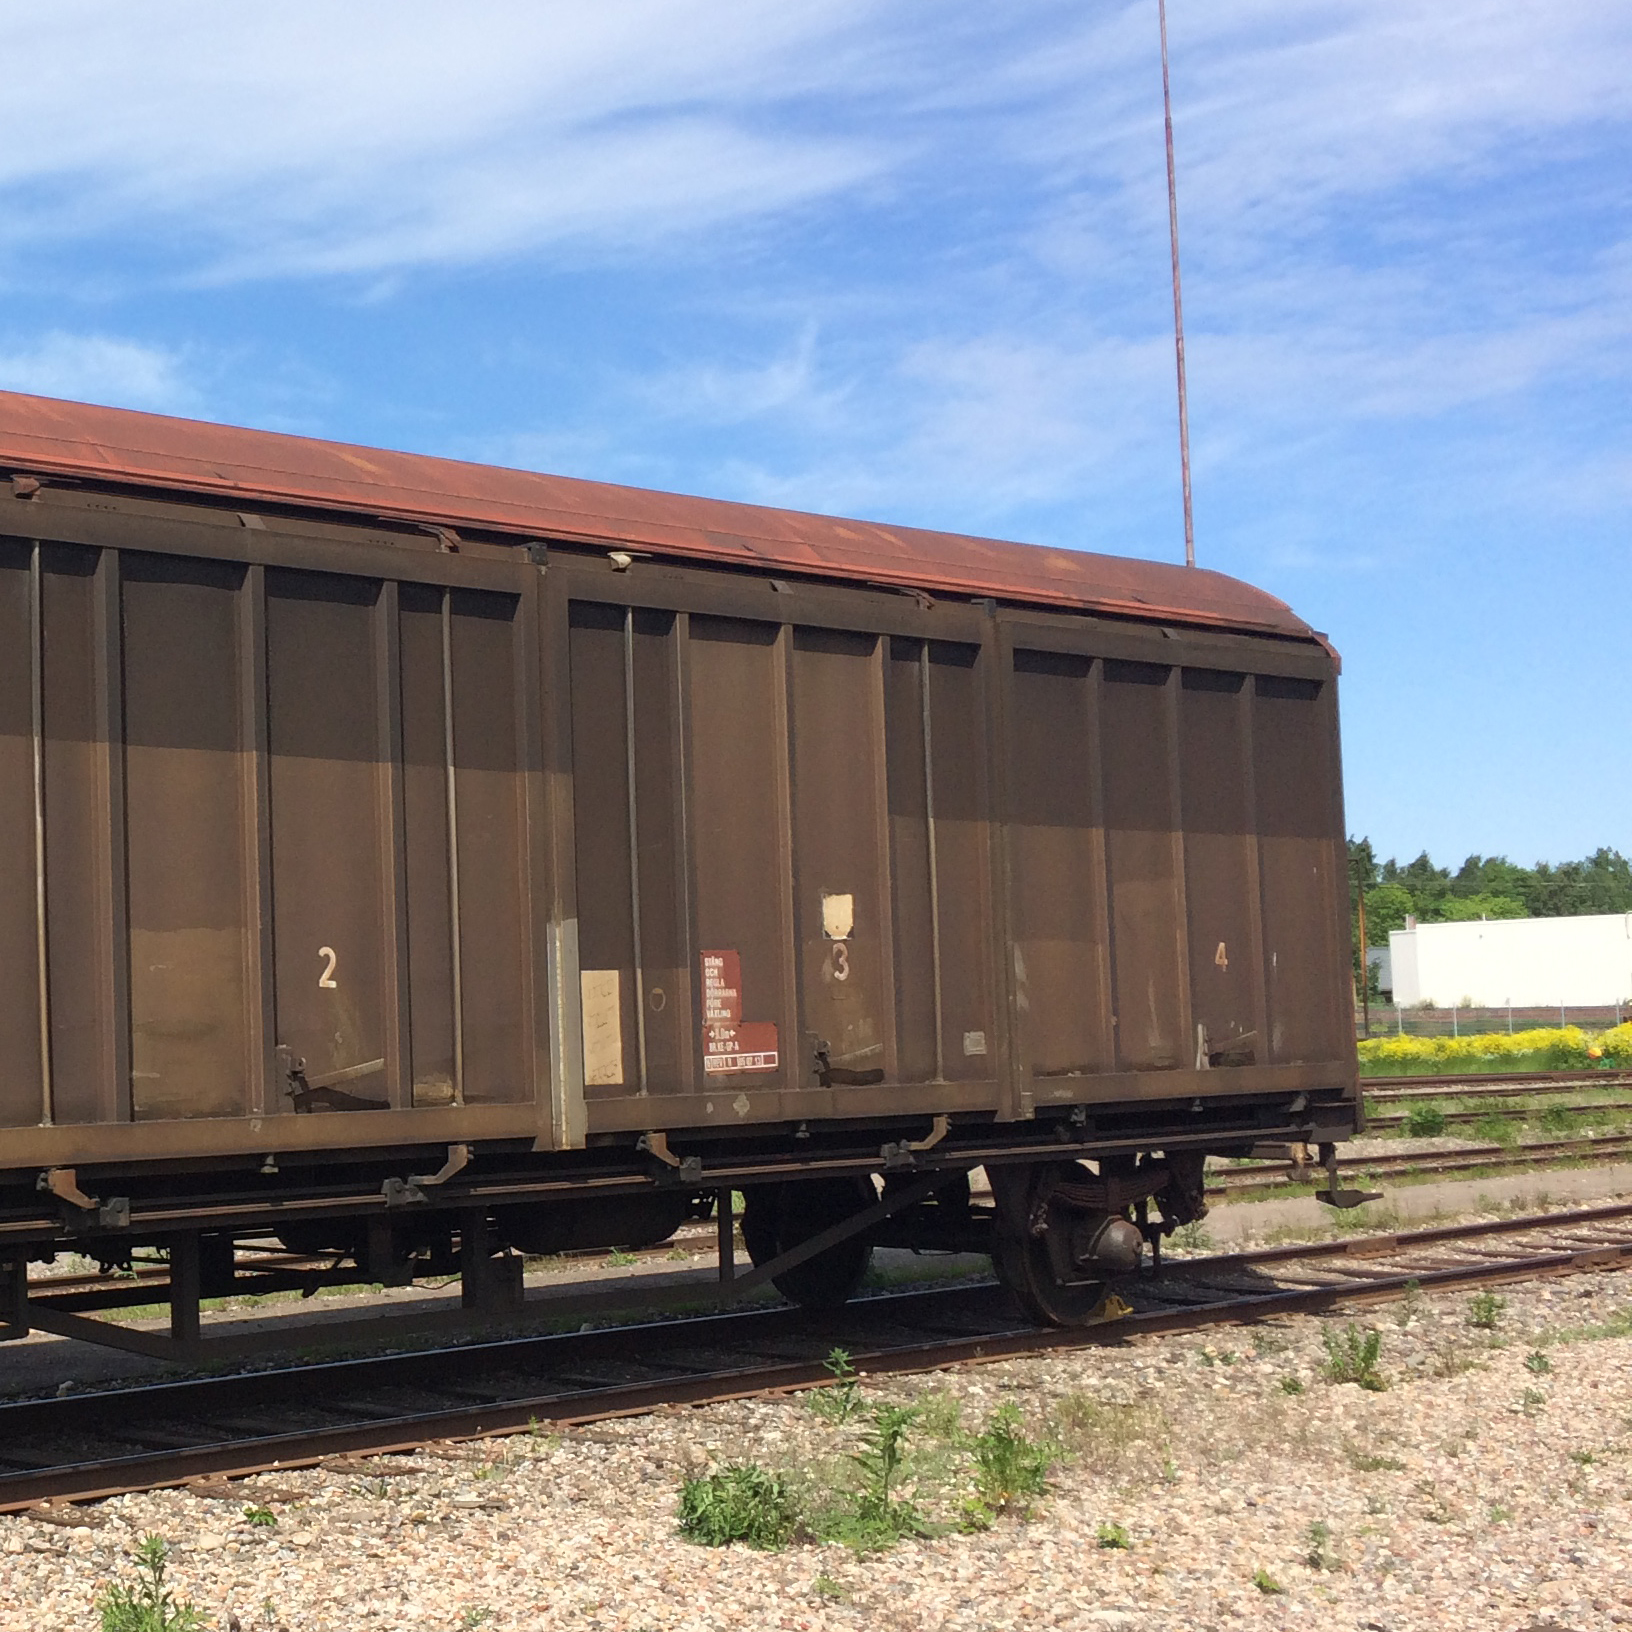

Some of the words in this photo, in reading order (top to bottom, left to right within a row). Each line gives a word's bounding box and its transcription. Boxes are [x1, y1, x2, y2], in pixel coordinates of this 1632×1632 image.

[318, 946, 337, 988] 2
[832, 942, 849, 981] 3
[1214, 942, 1228, 972] 4
